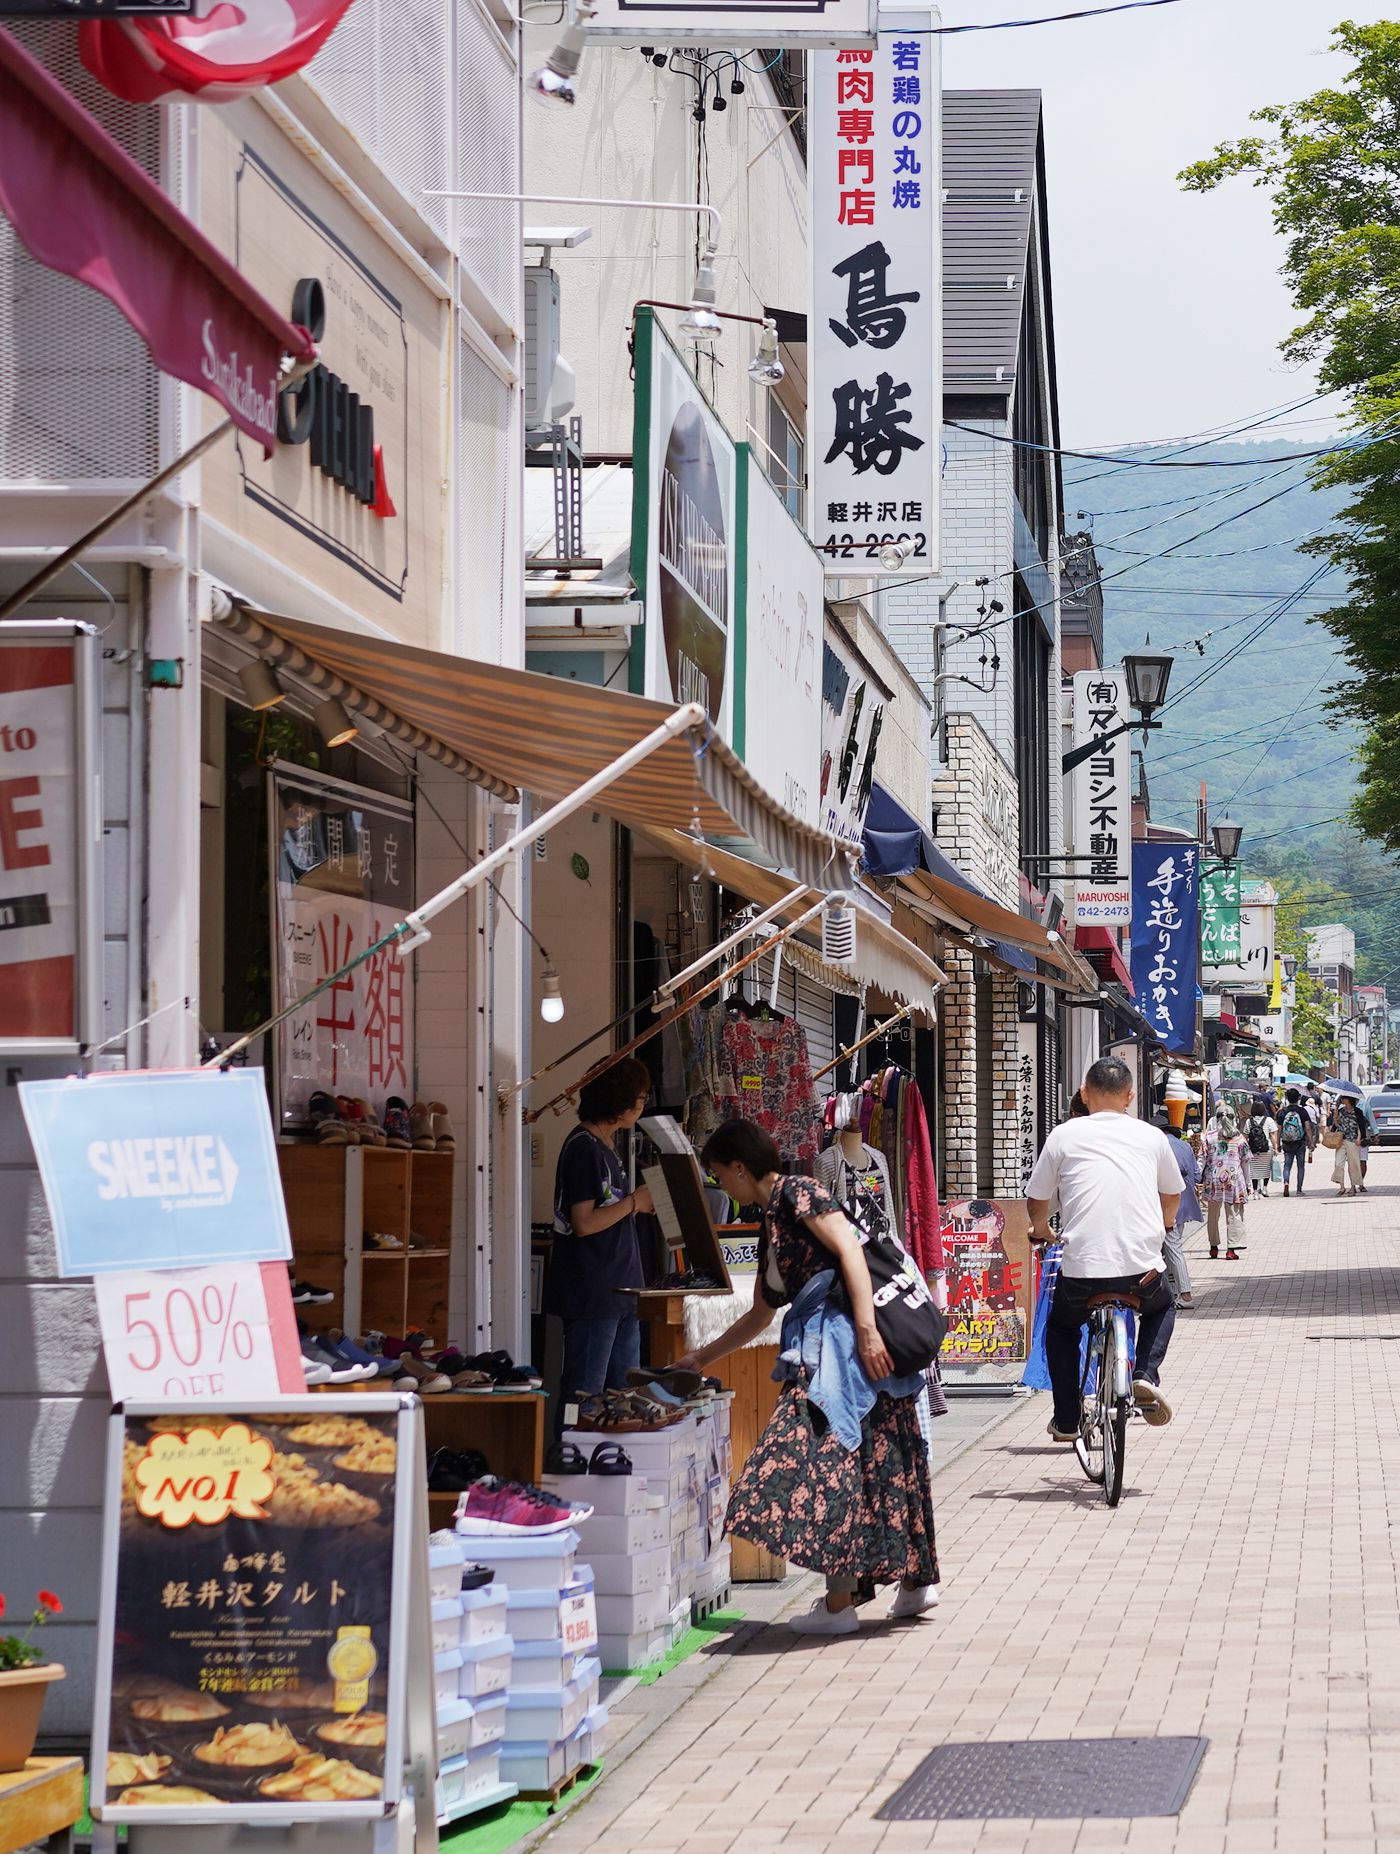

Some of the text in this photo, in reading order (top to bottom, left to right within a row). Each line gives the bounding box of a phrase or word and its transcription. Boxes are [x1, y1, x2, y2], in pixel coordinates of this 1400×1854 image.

[892, 41, 922, 210] 若鶏の丸焼
[824, 240, 925, 476] 鳥勝
[827, 500, 923, 523] 軽井沢店
[1077, 892, 1129, 903] MARUYOSHI
[1086, 906, 1130, 916] 42-2473
[1202, 883, 1220, 942] うどん
[1221, 883, 1239, 942] そば
[1146, 856, 1185, 1039] 手造りおかき
[316, 912, 408, 1091] 半額
[947, 1261, 1024, 1307] ALE
[125, 1281, 254, 1372] 50%
[940, 1337, 1013, 1354] ギャラリー
[954, 1320, 997, 1335] ART
[161, 1578, 347, 1609] 軽井沢タルト
